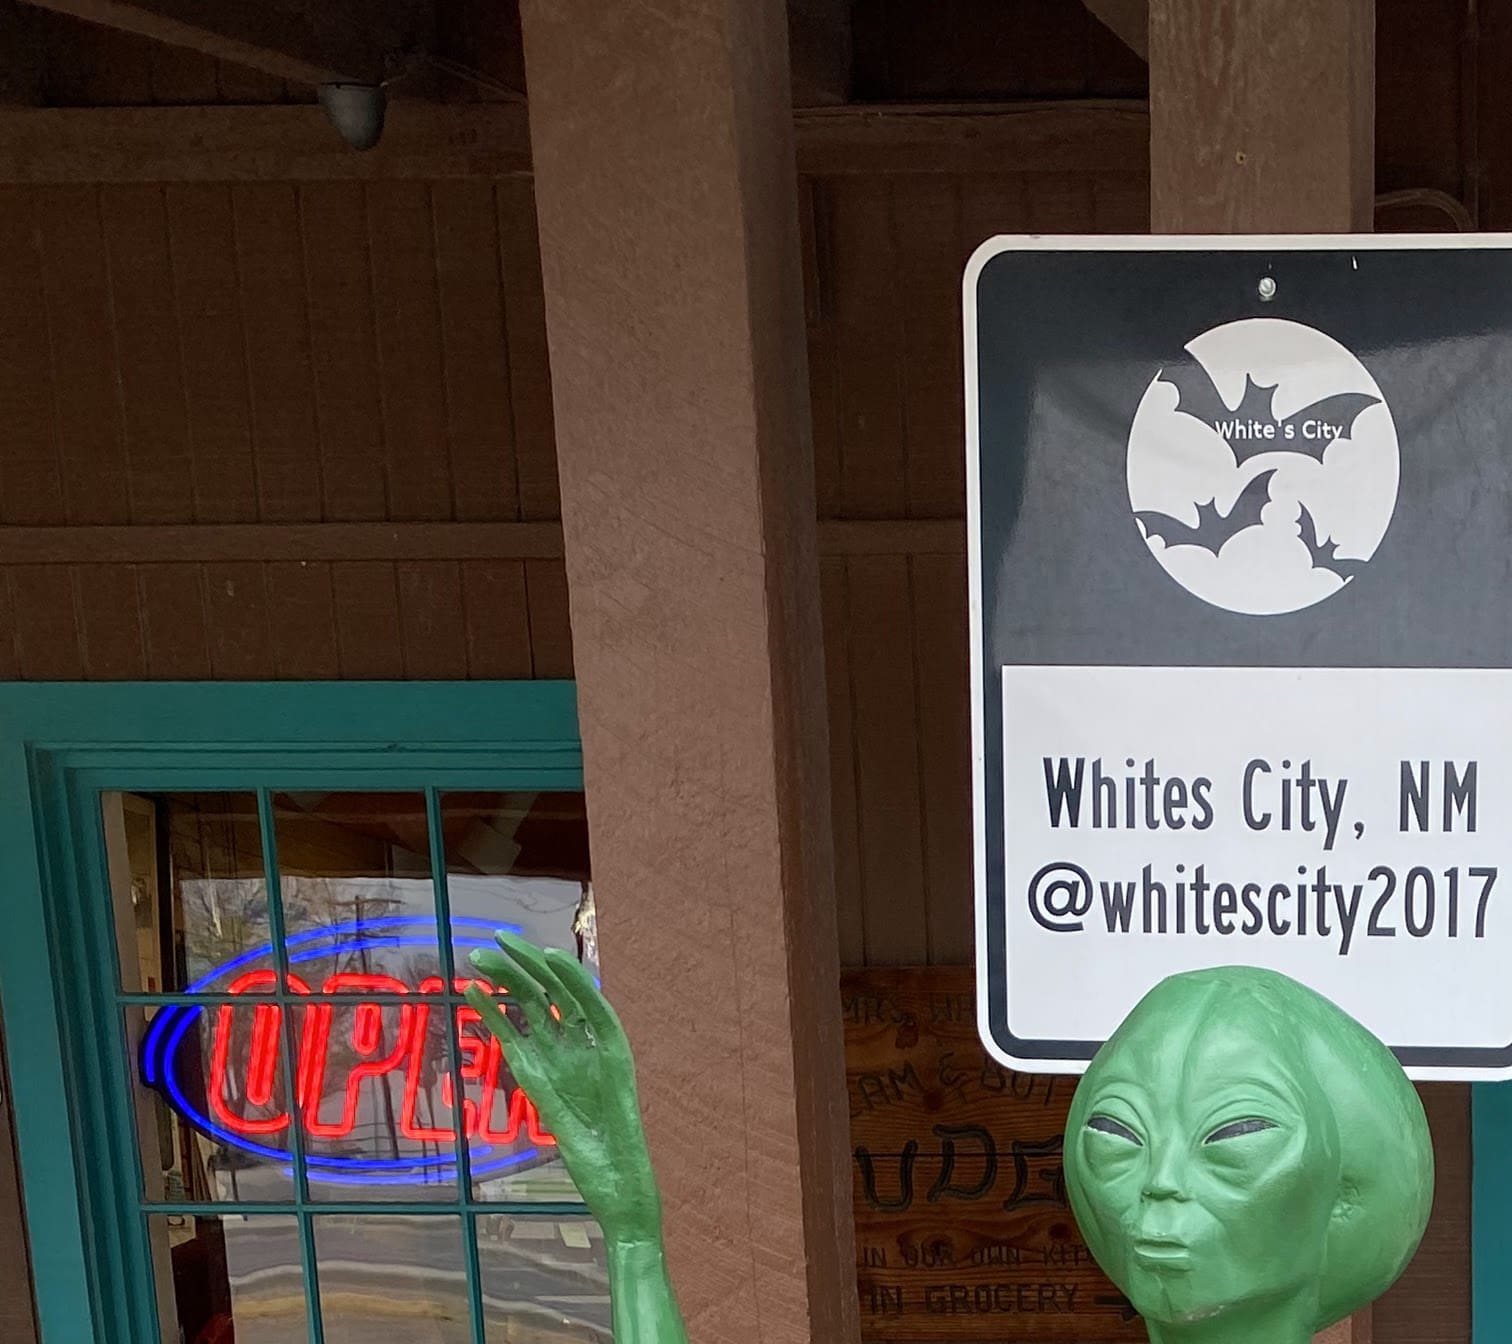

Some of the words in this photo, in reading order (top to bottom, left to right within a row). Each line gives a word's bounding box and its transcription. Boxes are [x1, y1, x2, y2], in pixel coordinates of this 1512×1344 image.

[1215, 419, 1295, 440] White's
[1302, 420, 1343, 441] City
[1042, 756, 1214, 831] Whites
[1242, 759, 1366, 850] City,
[1399, 760, 1479, 833] NM
[1027, 862, 1498, 955] @whitescity2017
[854, 1123, 1068, 1213] UDG
[1043, 1244, 1095, 1265] KIT
[869, 1285, 903, 1315] IN
[925, 1284, 1079, 1314] GROCERY
